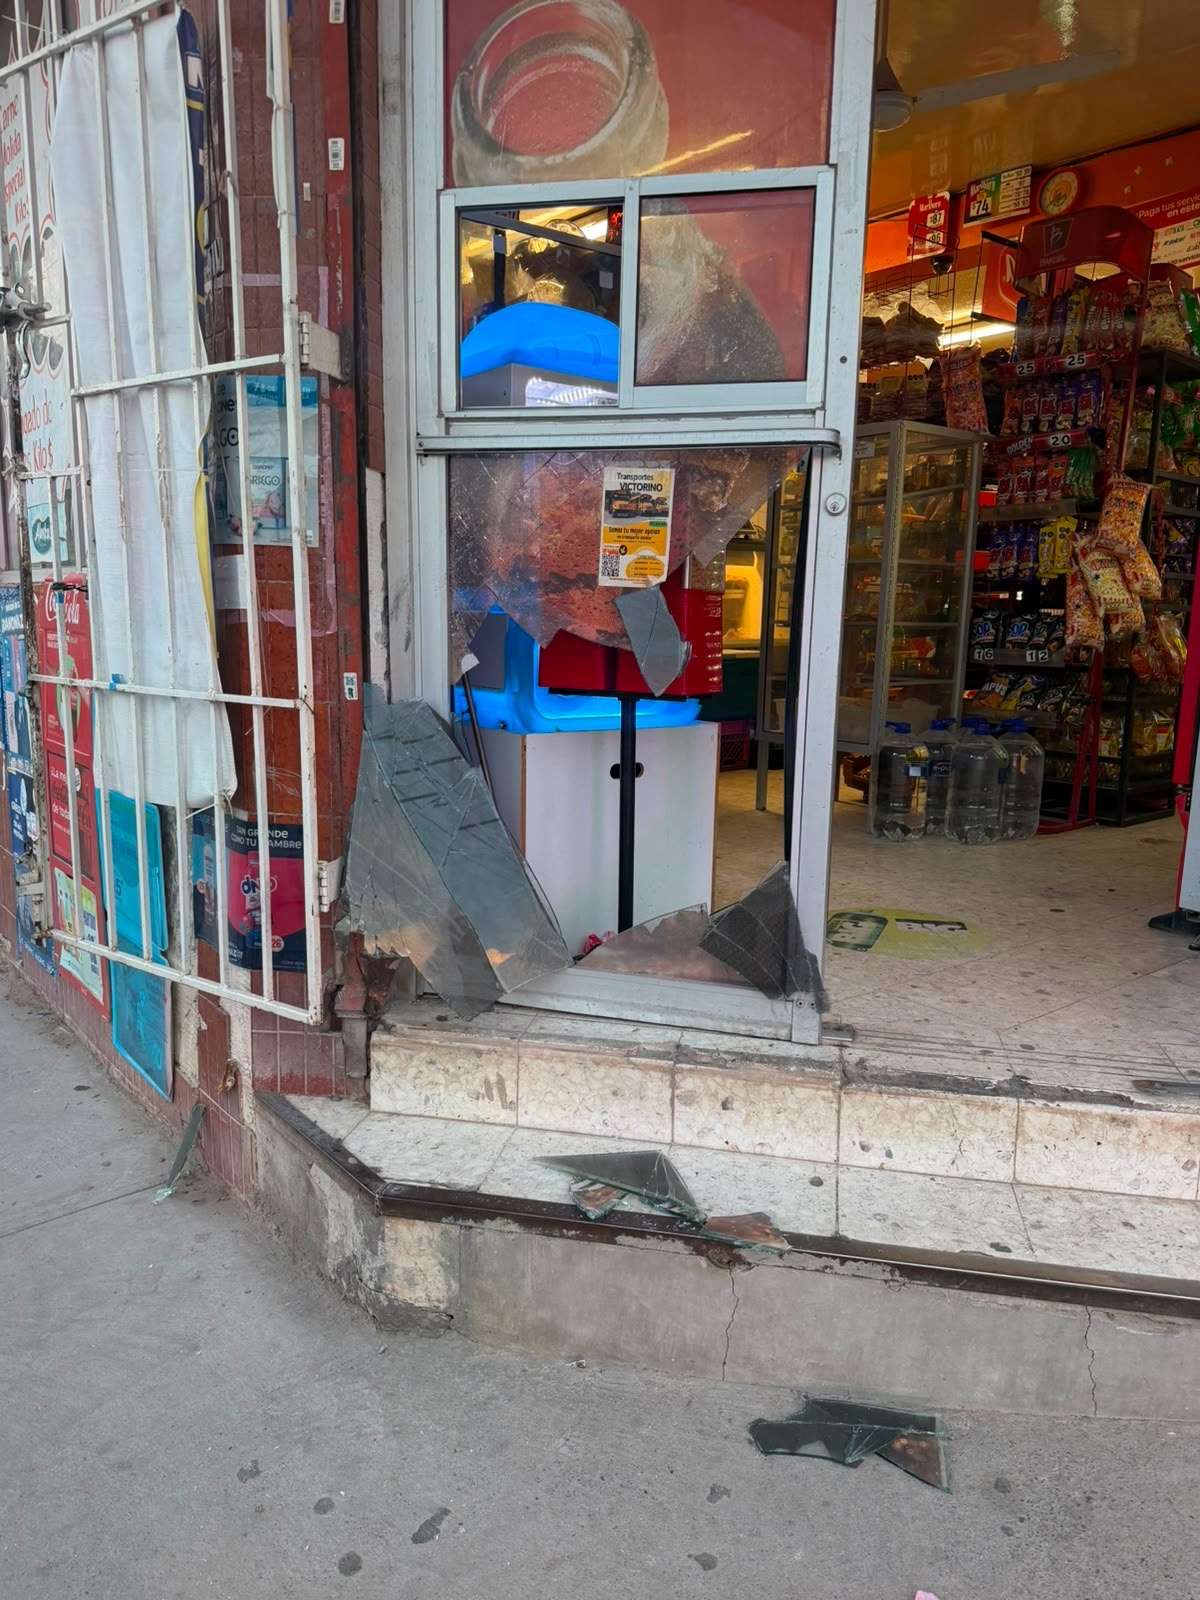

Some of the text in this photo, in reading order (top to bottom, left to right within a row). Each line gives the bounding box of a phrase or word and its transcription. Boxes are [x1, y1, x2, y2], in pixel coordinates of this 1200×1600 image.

[1067, 355, 1085, 367] 25
[1018, 362, 1034, 375] 25
[1051, 434, 1071, 447] 20
[617, 472, 654, 482] Transportes
[620, 482, 663, 493] VICTORINO
[1027, 650, 1048, 662] 12
[246, 838, 257, 847] TU
